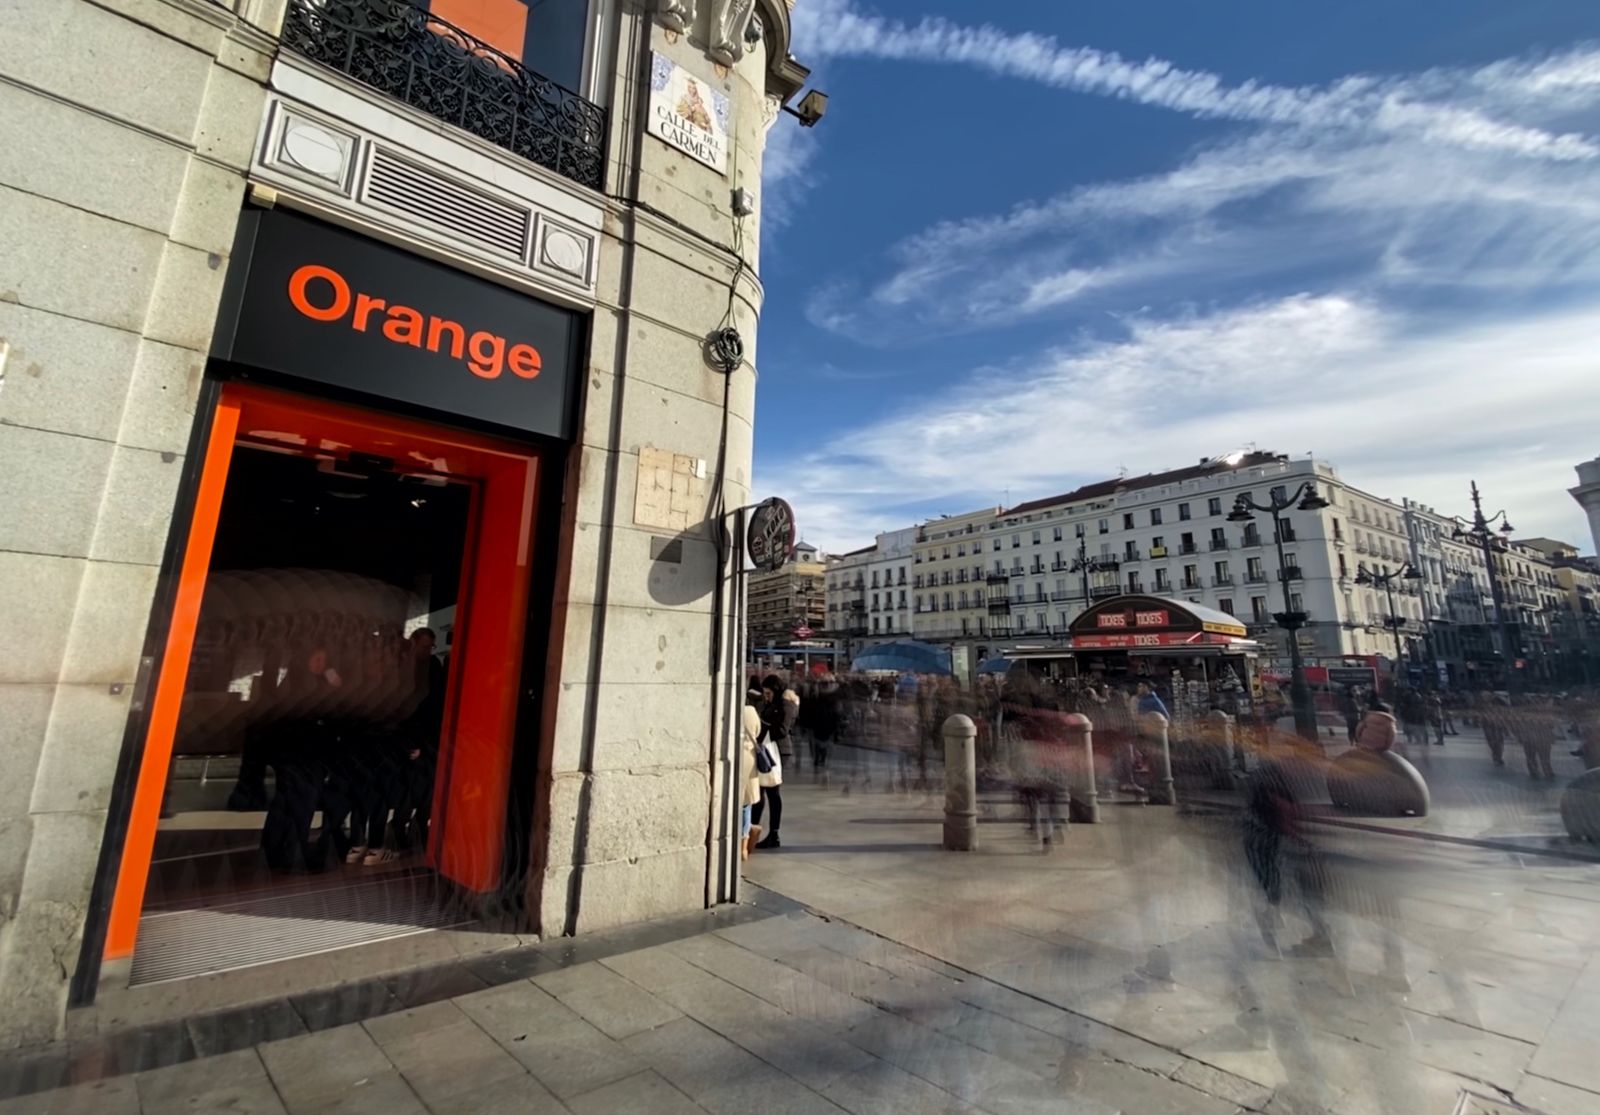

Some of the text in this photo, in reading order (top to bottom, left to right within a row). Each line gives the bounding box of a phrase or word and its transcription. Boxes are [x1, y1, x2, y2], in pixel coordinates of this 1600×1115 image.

[657, 105, 721, 150] CALLE DEL
[660, 121, 717, 165] CARMEN
[288, 264, 542, 380] Orange
[1100, 614, 1125, 627] TICKETS
[1136, 612, 1162, 626] TICKETS
[1134, 634, 1160, 646] TICKETS
